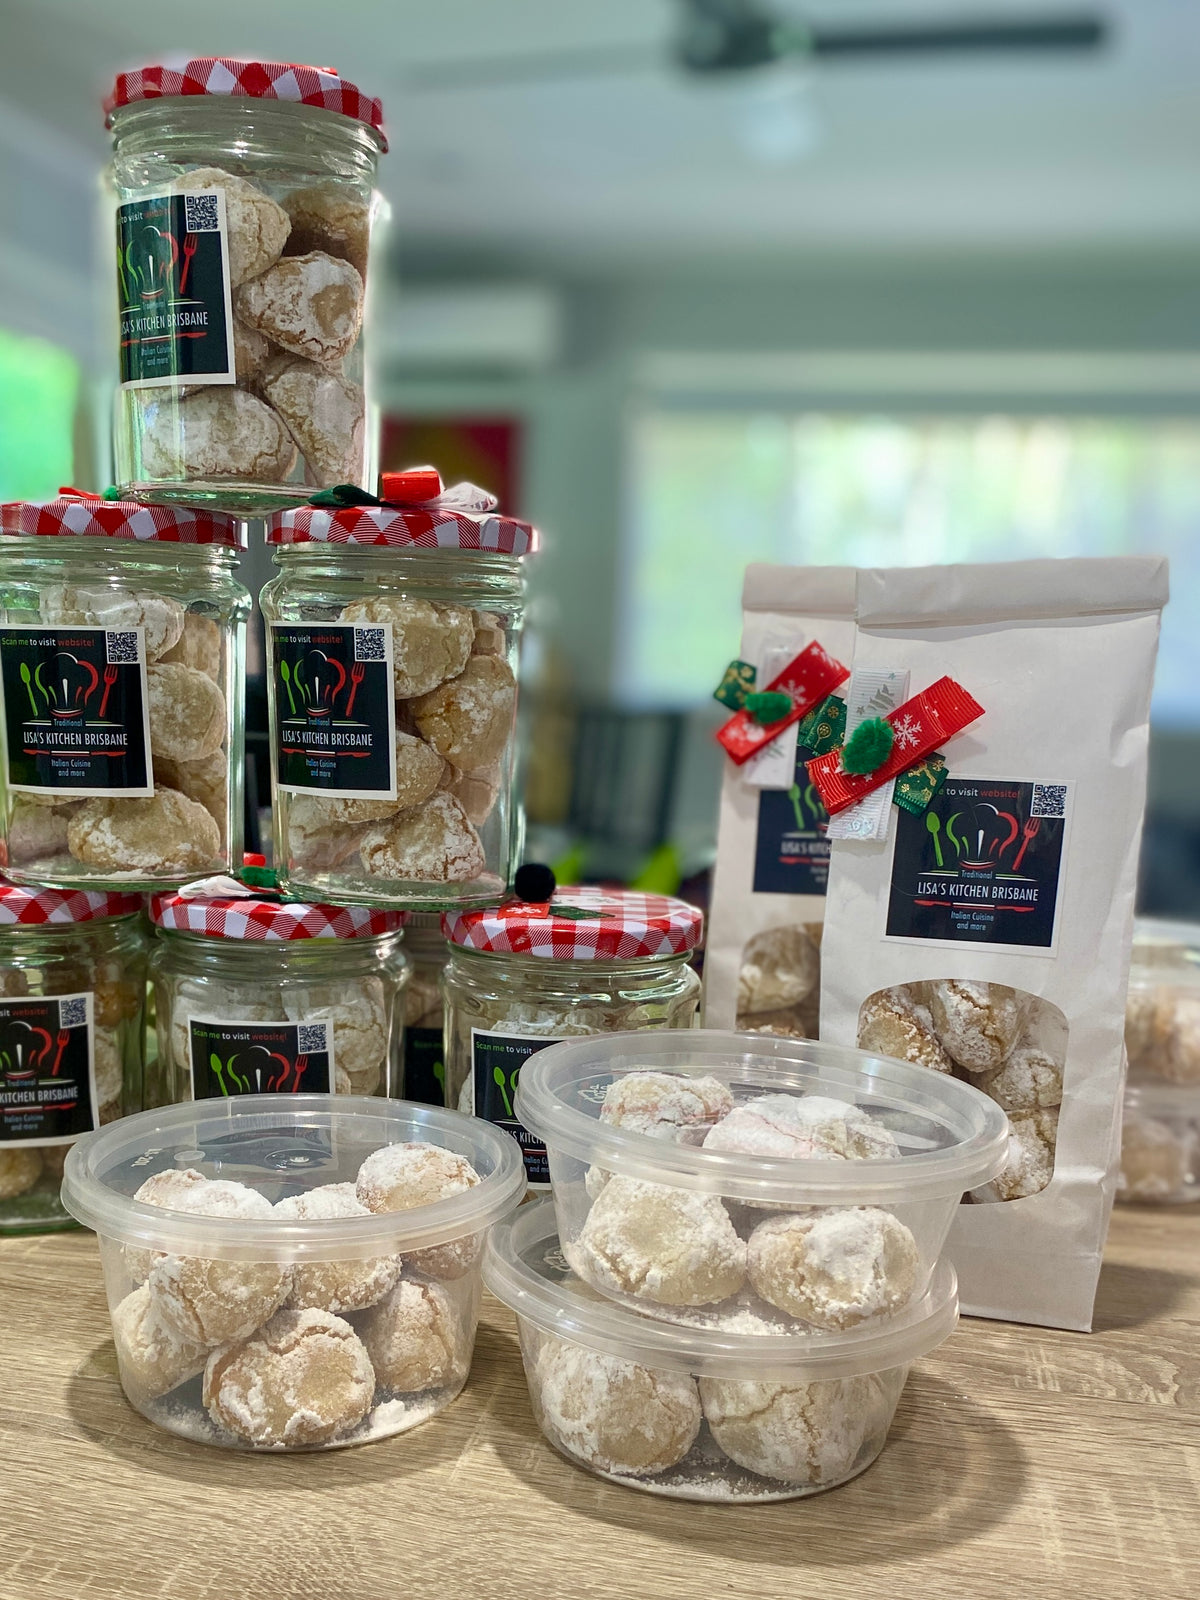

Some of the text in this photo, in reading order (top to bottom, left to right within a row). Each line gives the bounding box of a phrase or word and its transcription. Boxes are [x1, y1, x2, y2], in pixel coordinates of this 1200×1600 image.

[128, 211, 144, 222] visit
[136, 315, 166, 334] KITCHEN
[166, 311, 209, 328] BRISBANE
[1, 638, 18, 646] Scan
[29, 638, 38, 646] to
[38, 638, 56, 647] visit
[57, 638, 95, 647] website!
[290, 635, 297, 643] to
[297, 634, 312, 643] visit
[312, 635, 343, 644] website!
[53, 718, 83, 727] Traditional
[23, 732, 128, 746] LISA'S KITCHEN BRISBANE
[282, 730, 373, 746] LISA'S KITCHEN BRISBANE
[51, 759, 91, 768] Italian Cuisine
[319, 759, 337, 768] Cuisine
[58, 768, 69, 777] and
[310, 768, 319, 777] and
[946, 788, 956, 796] to
[958, 787, 979, 797] visit
[961, 870, 993, 880] Traditional
[917, 882, 1039, 901] LISA'S KITCHEN BRISBANE
[951, 911, 994, 922] Italian Cuisine
[956, 921, 987, 931] and more
[0, 1008, 10, 1017] sit
[193, 1028, 208, 1038] Scan
[222, 1032, 231, 1040] to
[231, 1032, 250, 1040] visit
[251, 1032, 287, 1041] website!
[475, 1041, 492, 1051] Scan
[493, 1044, 505, 1052] me
[506, 1045, 515, 1053] to
[515, 1046, 533, 1055] visit
[0, 1086, 78, 1104] KITCHEN BRISBANE
[520, 1131, 547, 1144] KITC
